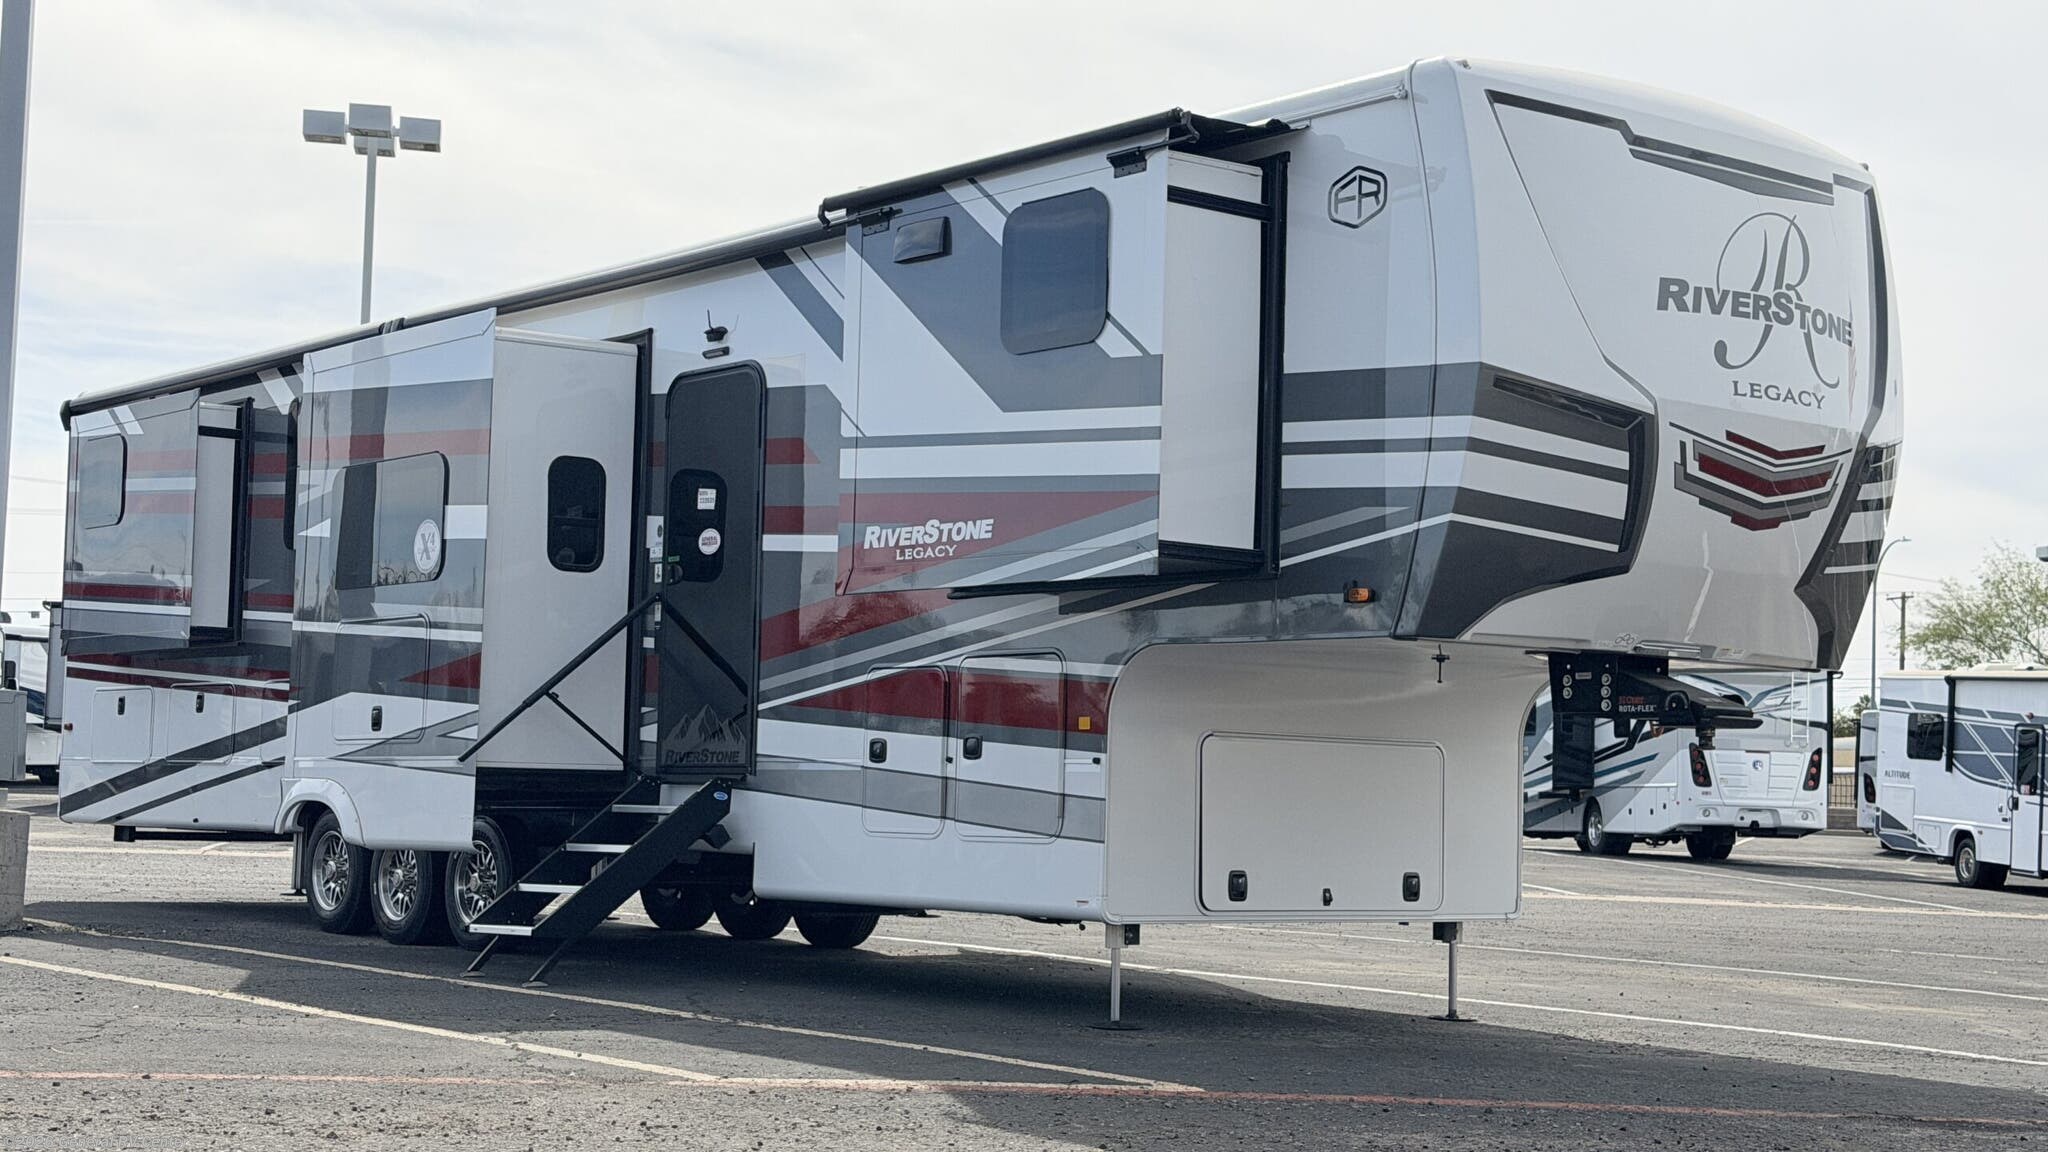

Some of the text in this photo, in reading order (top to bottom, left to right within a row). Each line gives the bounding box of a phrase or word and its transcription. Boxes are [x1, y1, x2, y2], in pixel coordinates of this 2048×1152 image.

[1656, 277, 1853, 347] RIVERSTONE
[1732, 380, 1826, 409] LEGACY
[863, 518, 994, 549] RIVERSTONE
[895, 545, 957, 560] LEGACY
[665, 748, 740, 763] RIVERSTONE
[1884, 770, 1910, 779] ALTITUDE
